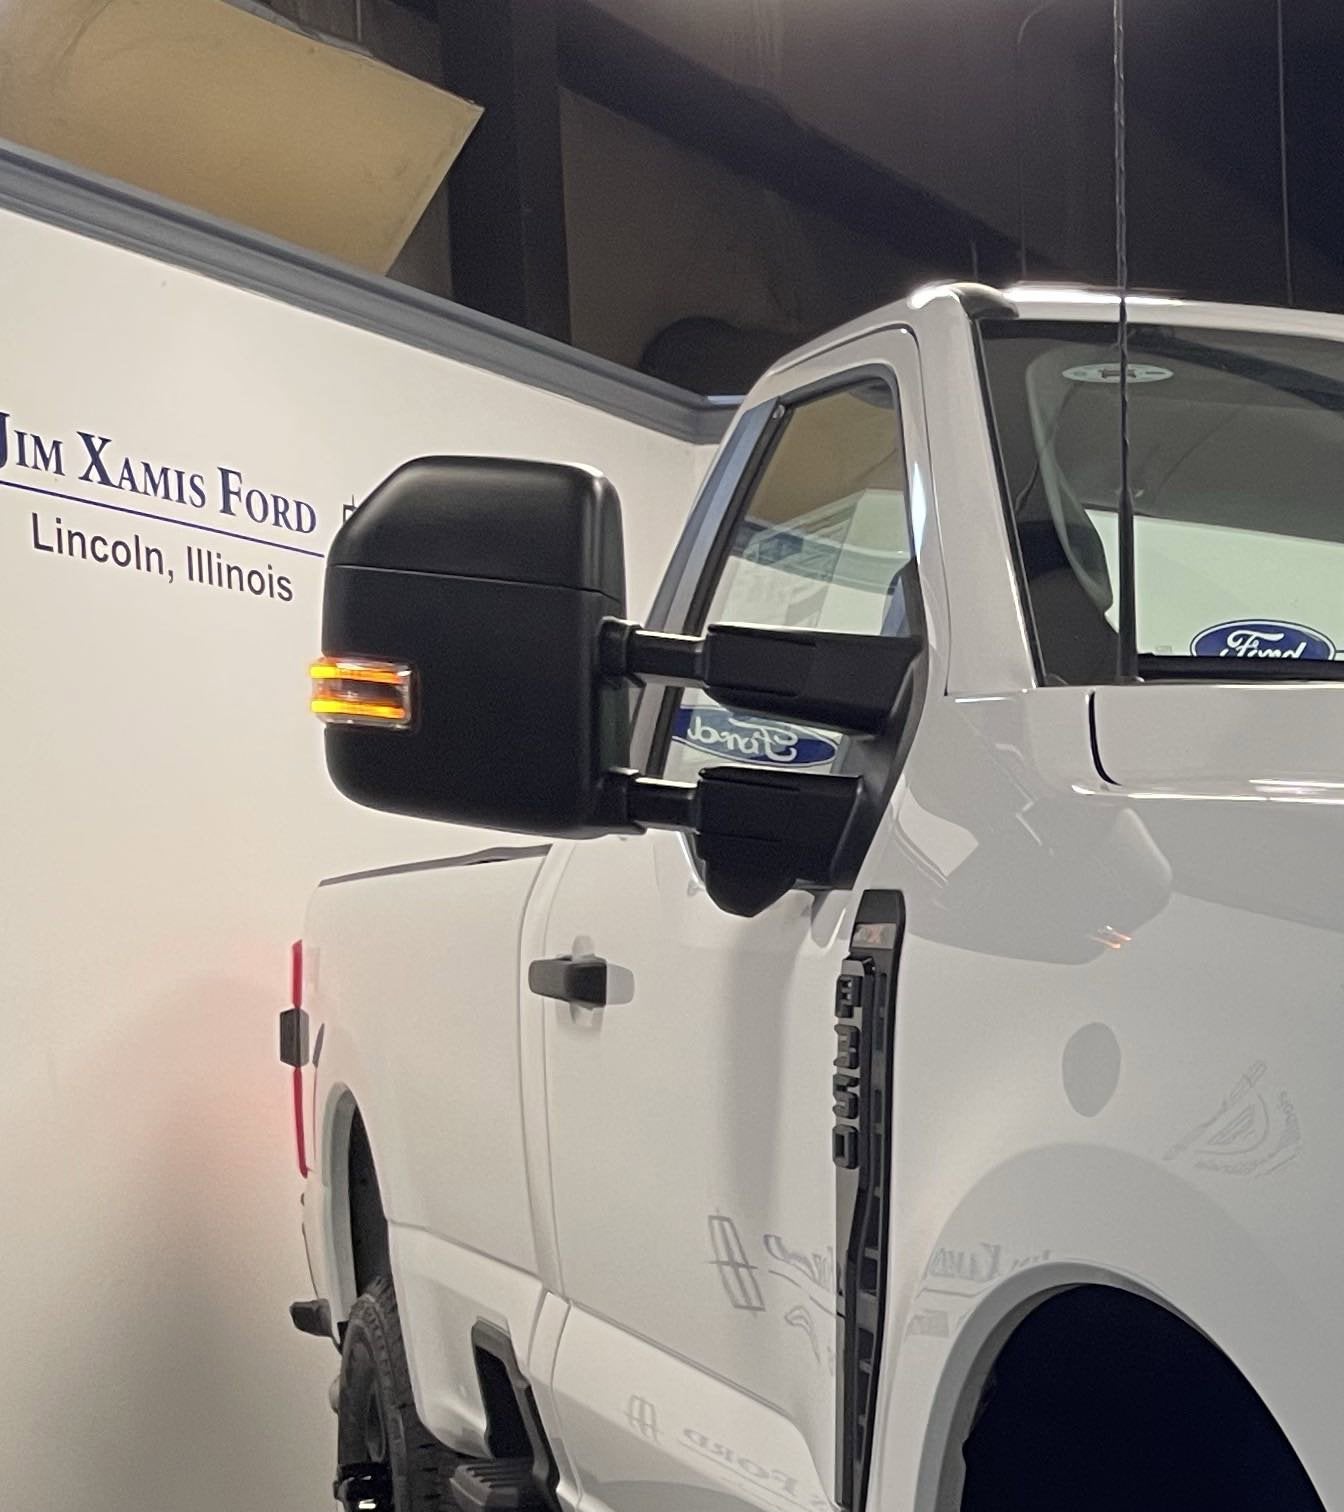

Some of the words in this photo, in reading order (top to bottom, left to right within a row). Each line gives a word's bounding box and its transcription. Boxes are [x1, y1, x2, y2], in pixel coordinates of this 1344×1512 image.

[76, 430, 208, 509] XAMIS
[217, 465, 318, 535] FORD
[31, 512, 175, 584] Lincoln,
[186, 545, 295, 603] Illinois
